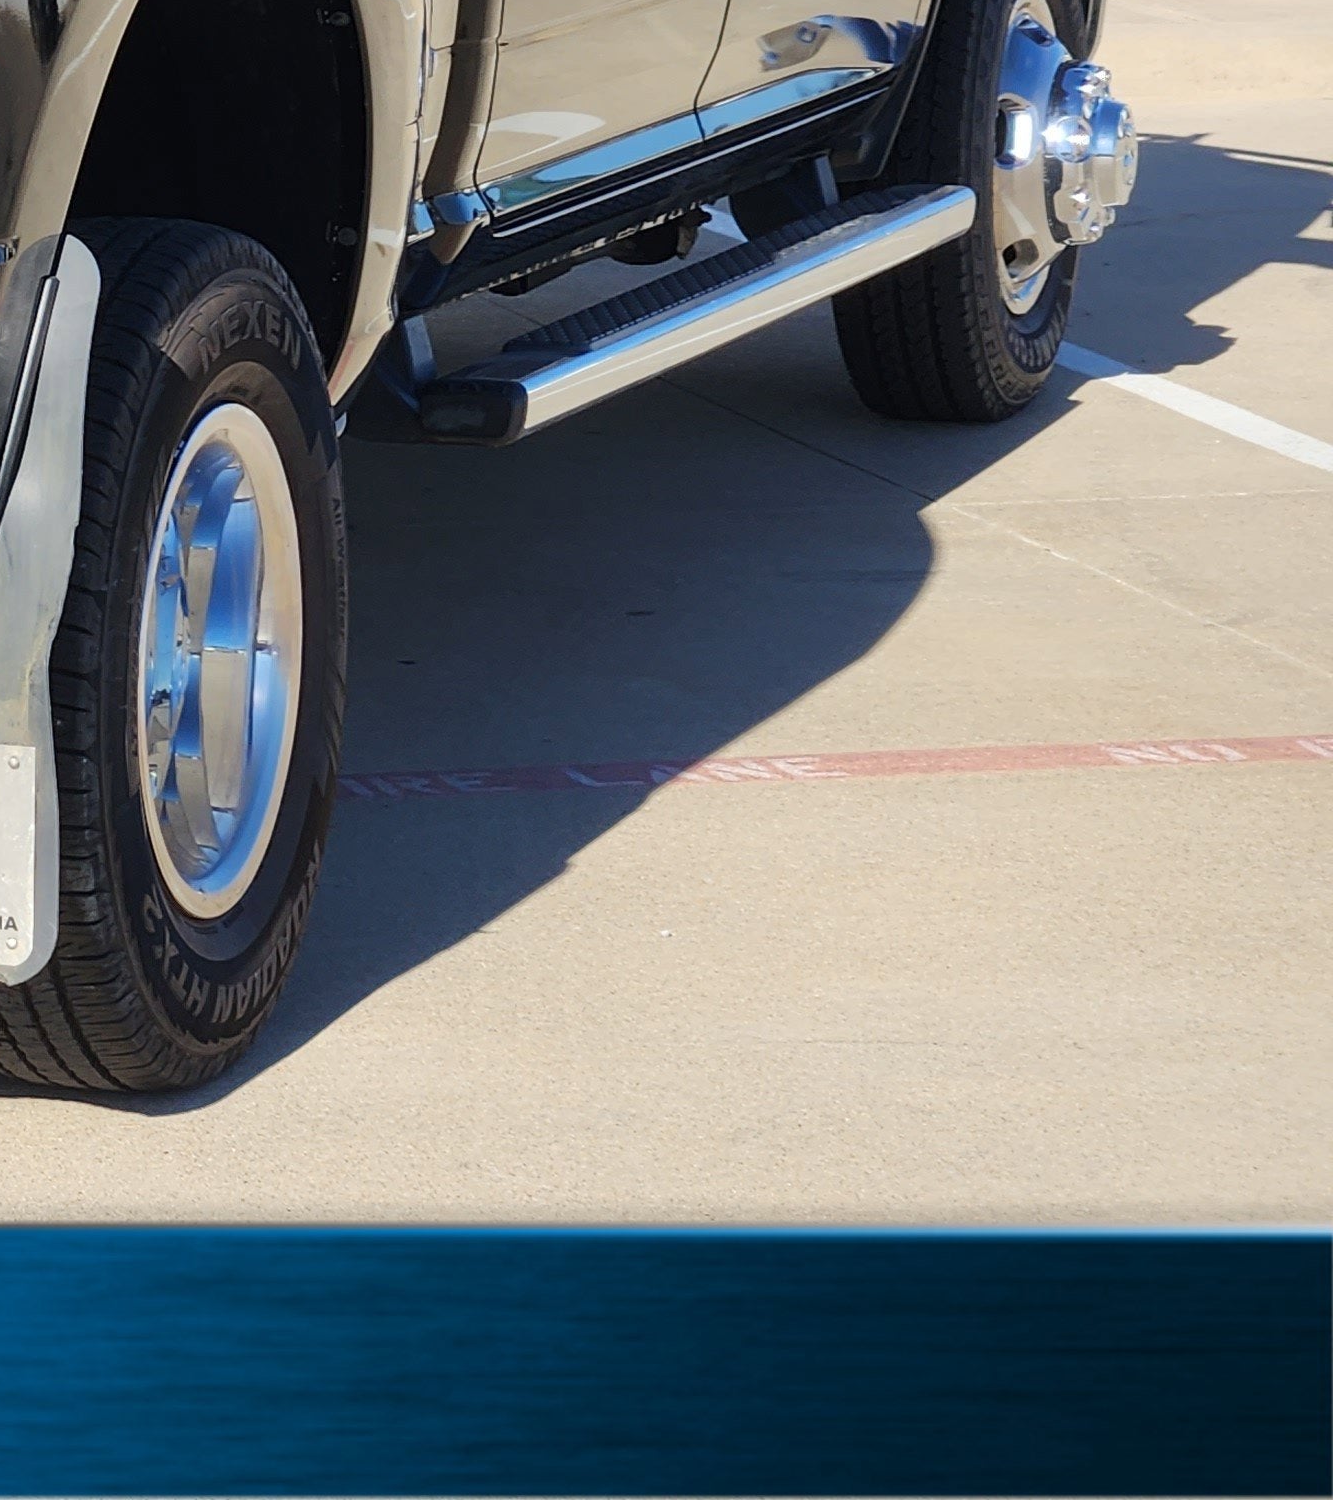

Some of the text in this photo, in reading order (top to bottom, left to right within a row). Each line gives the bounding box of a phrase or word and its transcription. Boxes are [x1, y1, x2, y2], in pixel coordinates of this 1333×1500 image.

[197, 300, 301, 372] NEXEN
[337, 744, 1247, 798] IRE LANE NO
